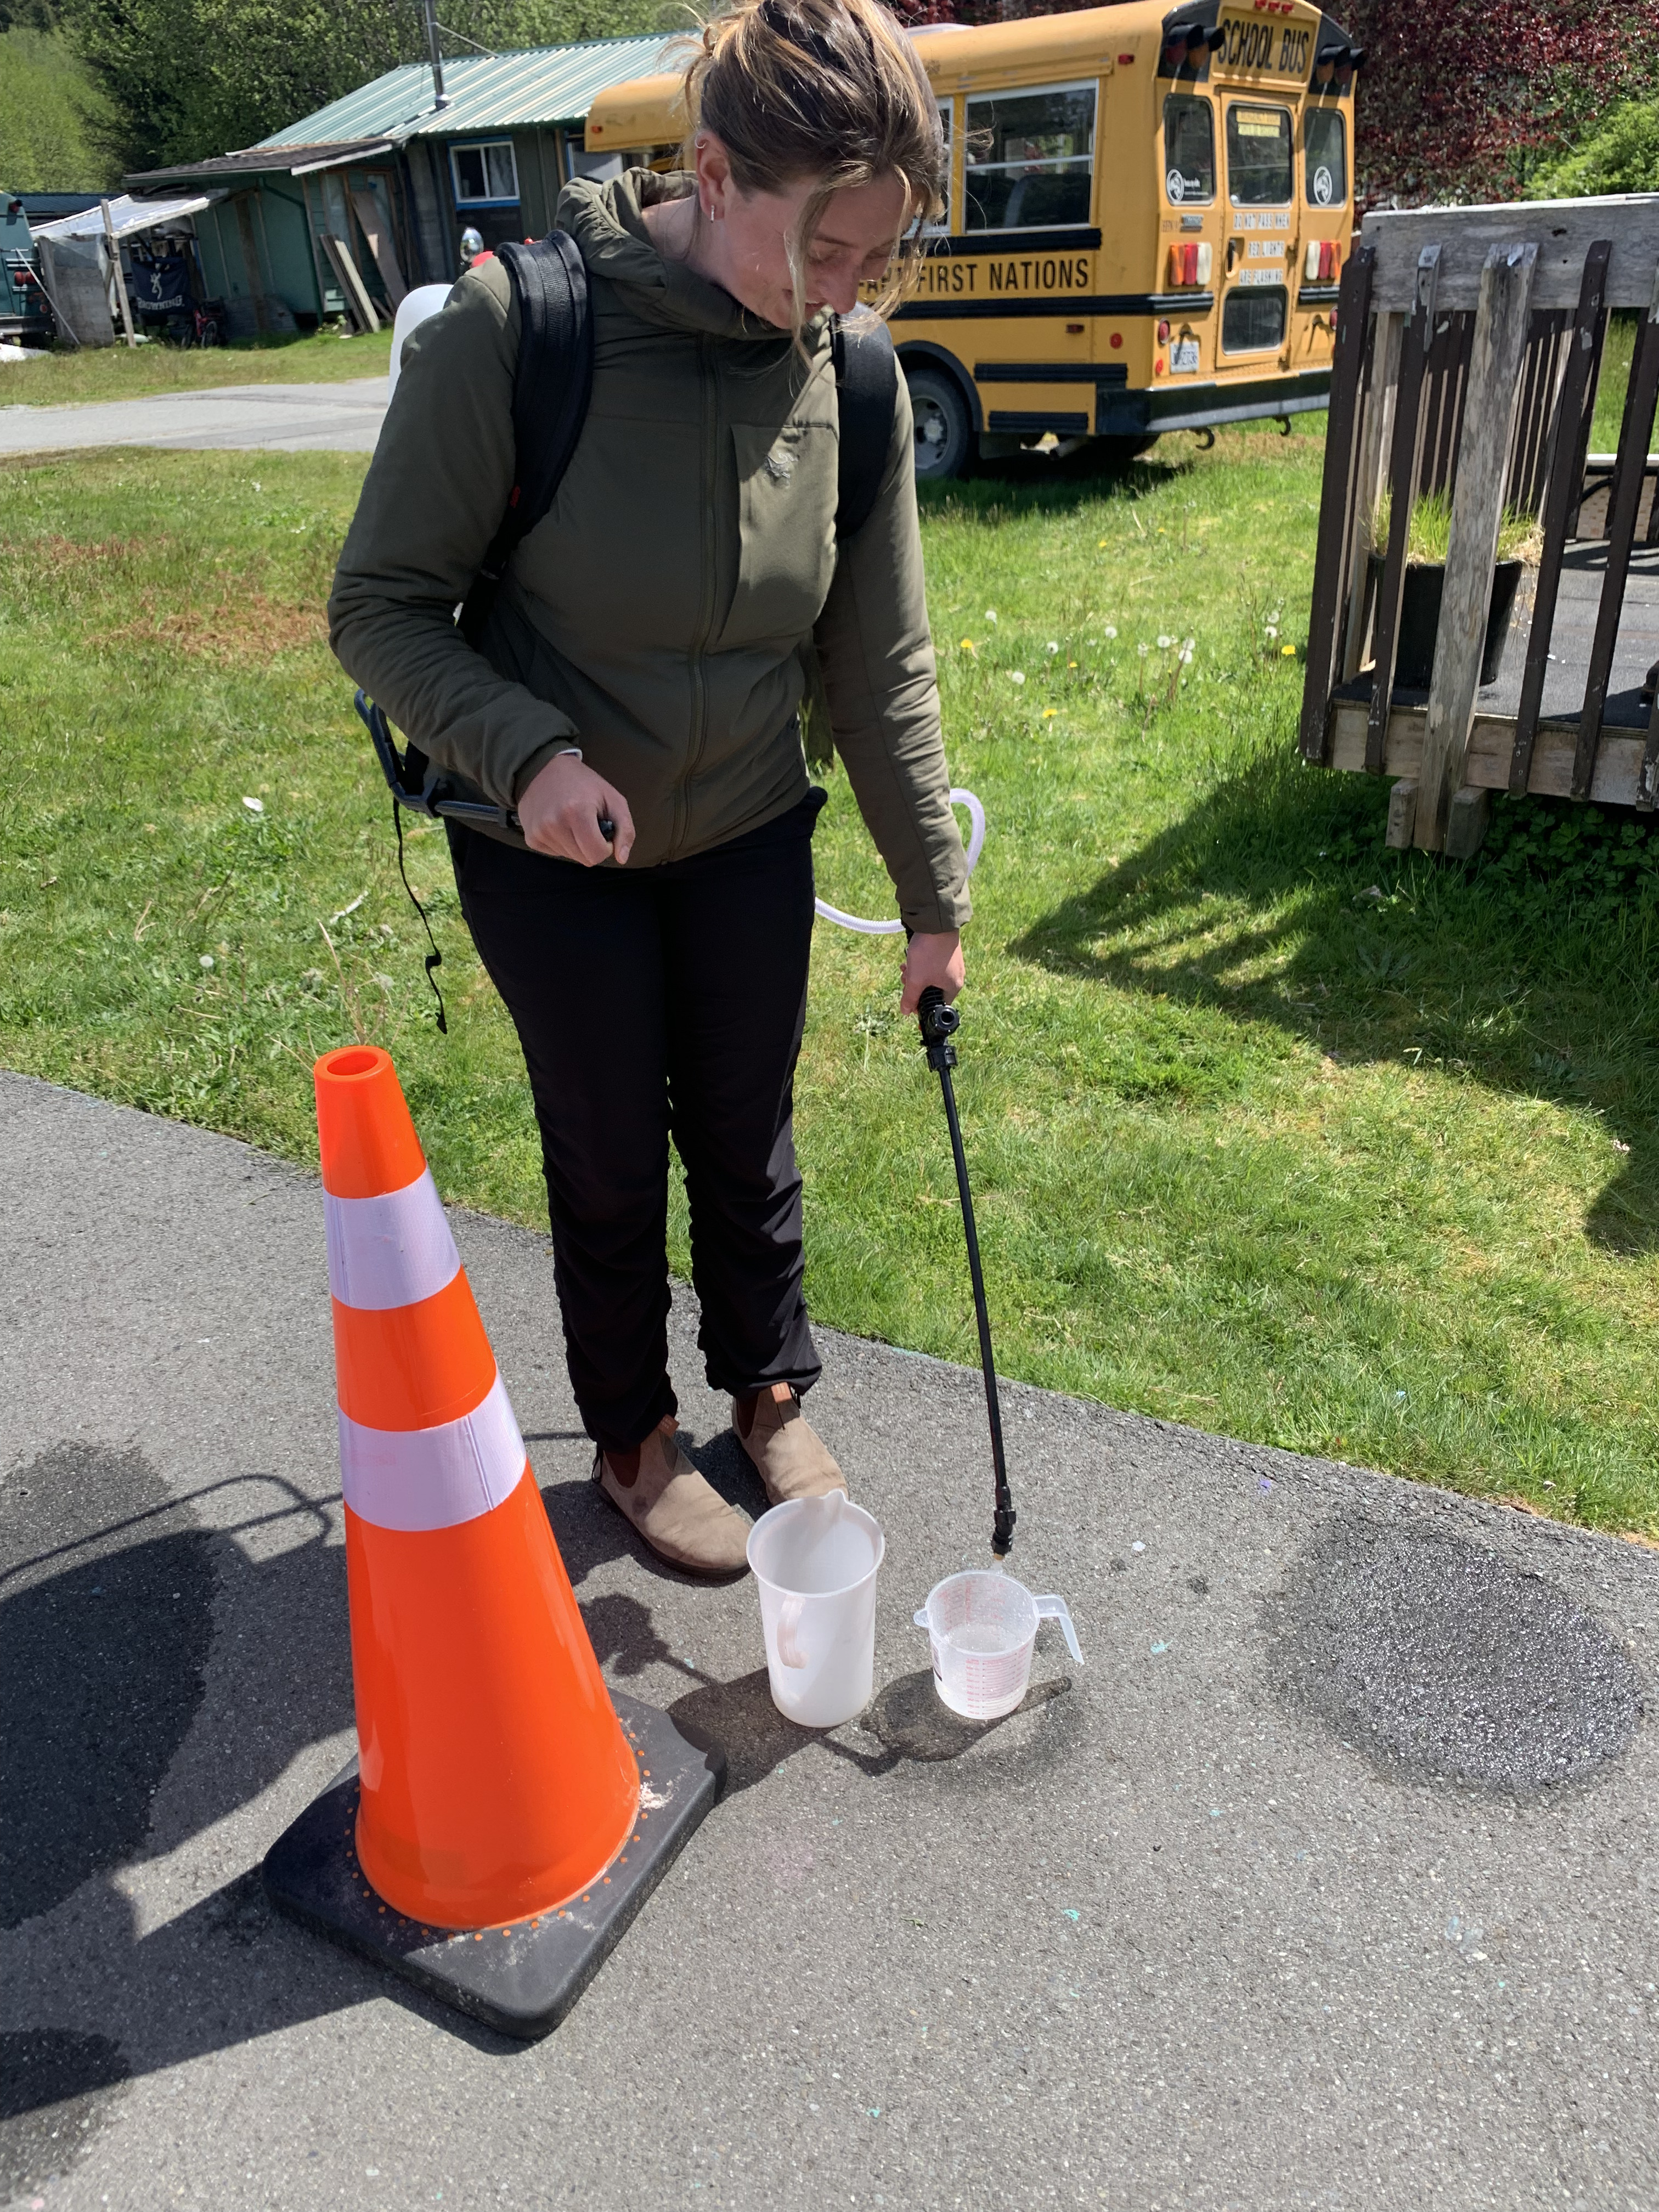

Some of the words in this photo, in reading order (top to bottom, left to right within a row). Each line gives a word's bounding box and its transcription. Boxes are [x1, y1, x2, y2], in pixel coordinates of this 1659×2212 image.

[1218, 18, 1274, 69] SCHOOL
[1278, 27, 1310, 74] BUS
[917, 264, 978, 292] FIRST
[990, 258, 1089, 290] NATIONS
